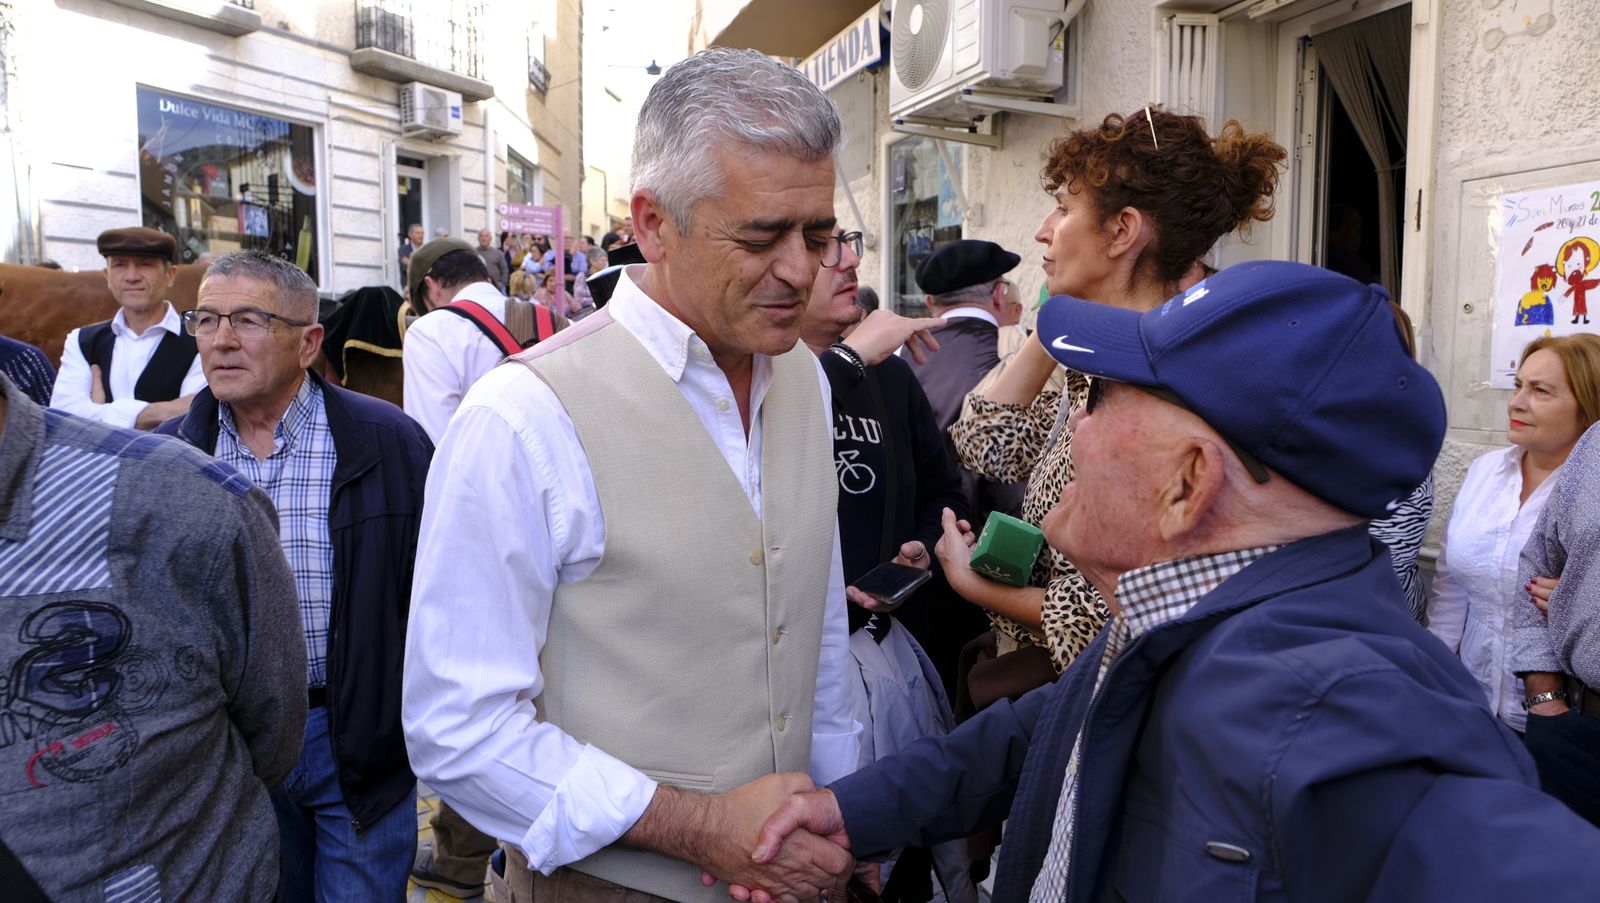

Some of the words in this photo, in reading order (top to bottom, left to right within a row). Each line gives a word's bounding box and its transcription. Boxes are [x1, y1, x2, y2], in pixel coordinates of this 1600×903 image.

[814, 17, 873, 86] TIENDA
[159, 98, 199, 118] Dulce
[202, 107, 231, 125] Vida
[833, 414, 885, 446] CLU
